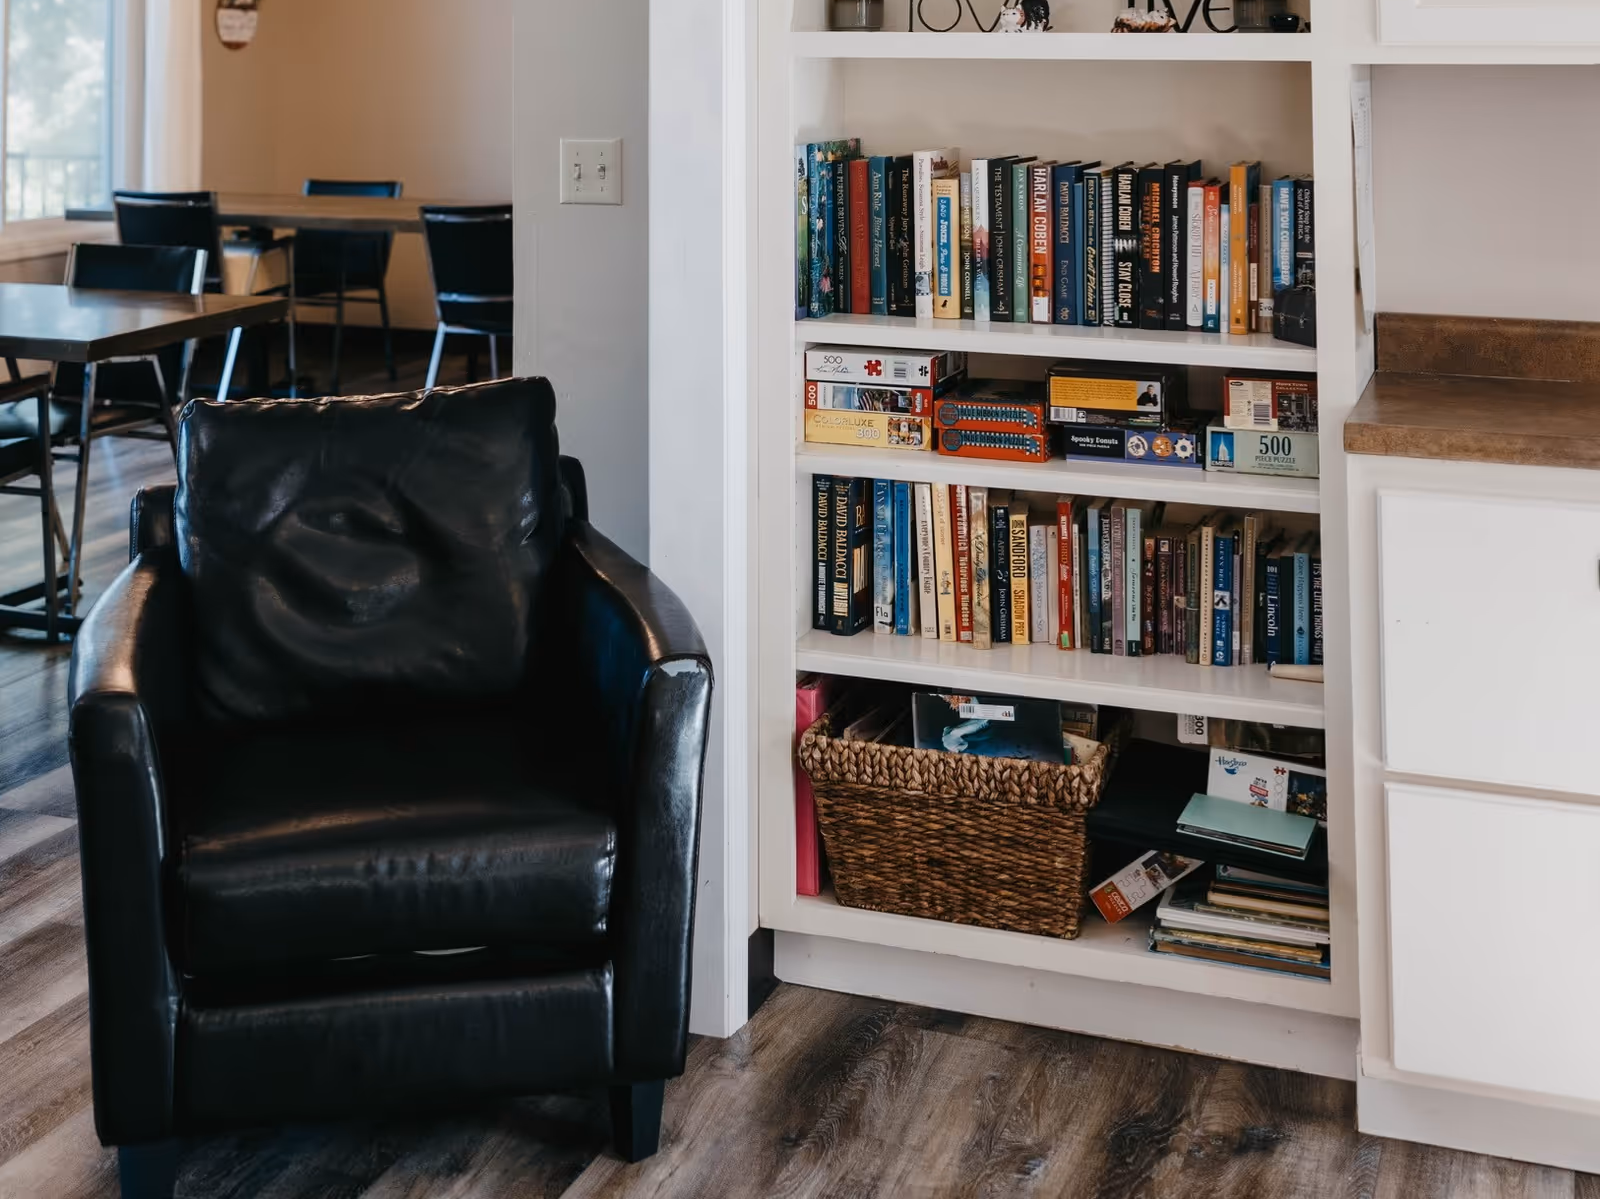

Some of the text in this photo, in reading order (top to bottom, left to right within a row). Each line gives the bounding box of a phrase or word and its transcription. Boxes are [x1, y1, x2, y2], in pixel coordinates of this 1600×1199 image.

[873, 170, 882, 211] Ann Rule
[901, 183, 909, 215] Runaway
[994, 167, 1003, 229] THE TESTAMENT
[1118, 173, 1132, 231] HARLAN COBEN
[1171, 175, 1179, 209] Honeymoon
[1303, 188, 1311, 210] Chicken
[901, 216, 909, 231] Jury
[1033, 167, 1047, 254] HARLAN COBEN
[1060, 181, 1069, 244] DAVID BALDACCI
[1171, 215, 1179, 230] James
[1303, 210, 1311, 224] Soup
[874, 215, 882, 267] Bitter Harvest
[1151, 182, 1160, 273] MICHAEL CRICHTON
[1171, 230, 1179, 252] Patterson
[1279, 187, 1290, 286] HAVE YOU CONSIDERED?
[837, 232, 848, 254] Life
[1016, 239, 1024, 274] Common
[918, 254, 926, 269] Leigh
[940, 265, 948, 273] &
[995, 235, 1004, 295] JOHN GRISHAM
[1061, 259, 1069, 274] END
[1087, 246, 1096, 273] Great
[940, 273, 948, 294] RIDDLES
[1087, 274, 1096, 307] Plains
[1118, 261, 1132, 308] STAY CLOSE
[1171, 281, 1179, 303] Roughan
[824, 355, 843, 364] 500
[808, 385, 816, 406] 500
[814, 415, 874, 428] COLORLUXE
[960, 408, 975, 417] BLUE
[976, 409, 999, 418] RIBBON
[1000, 410, 1023, 419] PUZZLE
[856, 428, 880, 439] 300
[962, 434, 979, 443] BLUE
[980, 435, 1003, 445] RIBBON
[1003, 436, 1025, 446] PUZZLE
[1071, 435, 1118, 445] Spooky Donuts
[1260, 435, 1292, 456] 500
[876, 482, 887, 521] FANNIE
[817, 491, 827, 560] DAVID BALDACCI
[835, 496, 847, 579] DAVID BALDACCI
[956, 511, 968, 551] Evanovich
[876, 524, 888, 560] FLAGG
[973, 540, 985, 567] Daily
[997, 539, 1005, 566] APPEAL
[1012, 529, 1026, 578] SANDFORD
[920, 520, 932, 594] Everyone's Country Estate
[1267, 566, 1278, 574] 101
[818, 591, 826, 615] MIDNIGHT
[833, 581, 848, 617] DAYLIGHT
[959, 555, 969, 627] Notorious Nineteen
[1296, 576, 1305, 605] Happens
[1312, 562, 1323, 639] IT'S THE LITTLE THINGS
[875, 606, 889, 618] Fla
[998, 588, 1007, 640] JOHN GRISHAM
[1014, 589, 1025, 637] SHADOW PREY
[1267, 595, 1278, 637] Lincoln
[1195, 715, 1204, 735] 300
[1215, 756, 1247, 767] Hasbro
[1111, 891, 1128, 913] ceaco
